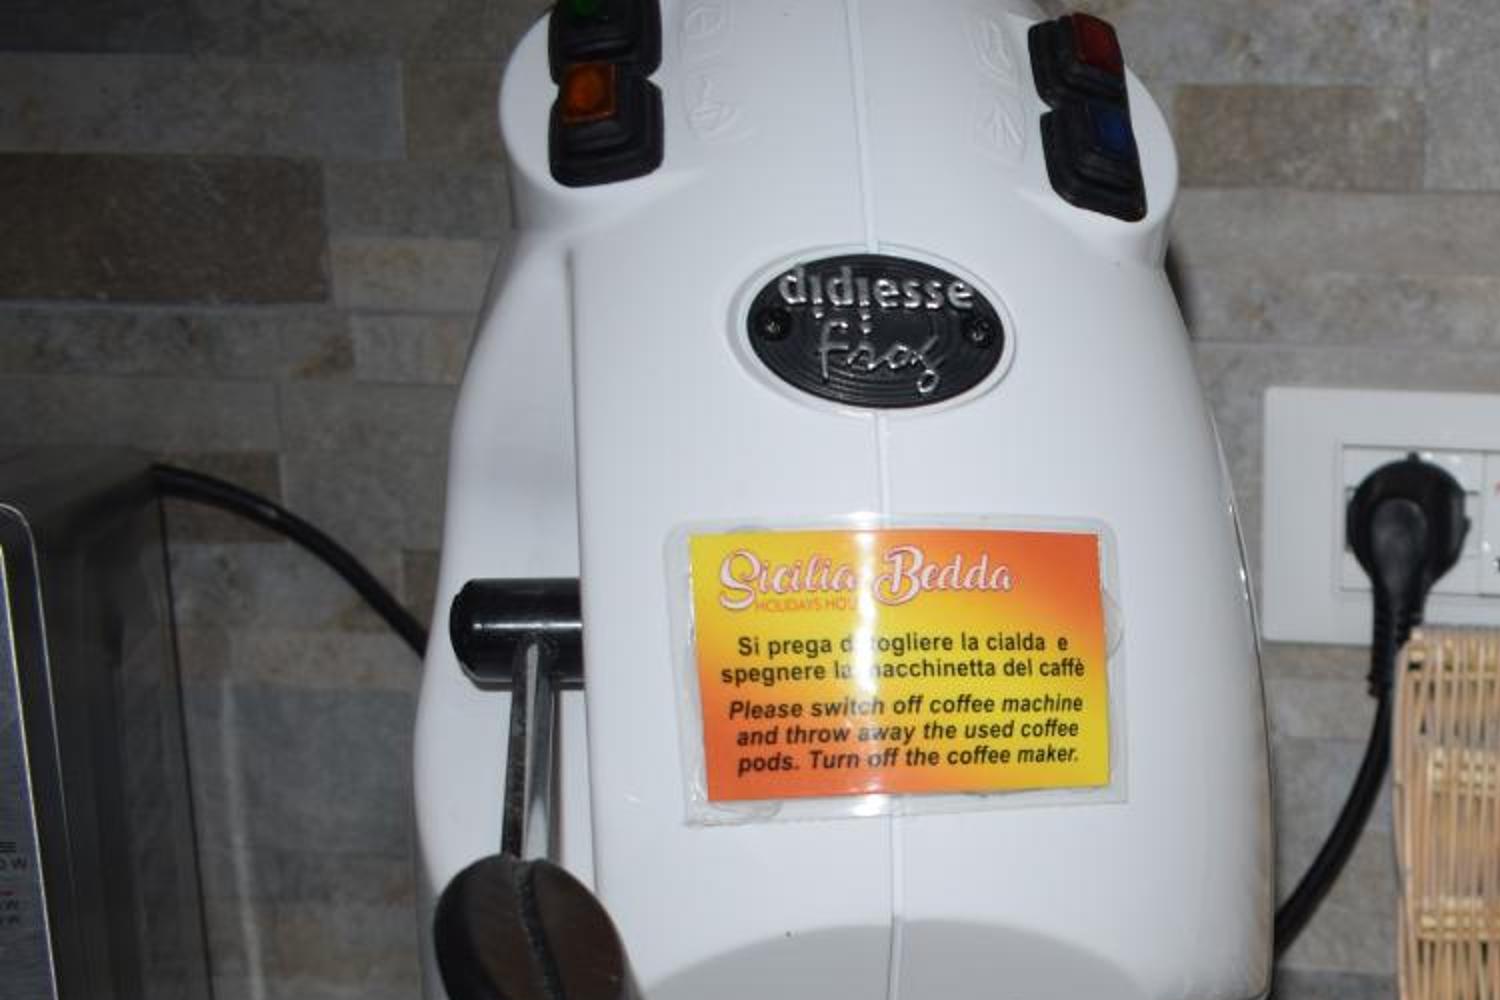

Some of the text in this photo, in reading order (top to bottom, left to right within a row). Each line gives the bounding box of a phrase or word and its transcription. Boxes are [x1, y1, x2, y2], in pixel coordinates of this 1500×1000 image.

[778, 264, 974, 316] didiesse
[718, 544, 1013, 609] Sicilia Bedda
[738, 636, 759, 657] Si
[769, 639, 832, 661] prega
[961, 632, 979, 651] la
[986, 632, 1045, 651] cialda
[1057, 636, 1069, 651] e
[721, 665, 826, 688] spegnere
[1003, 658, 1032, 677] del
[1039, 656, 1085, 677] caffè
[729, 693, 1083, 721] Please switch off coffee machine
[736, 718, 1079, 747] and throw away the used coffee
[737, 744, 1079, 778] pods. Turn off the coffee maker.
